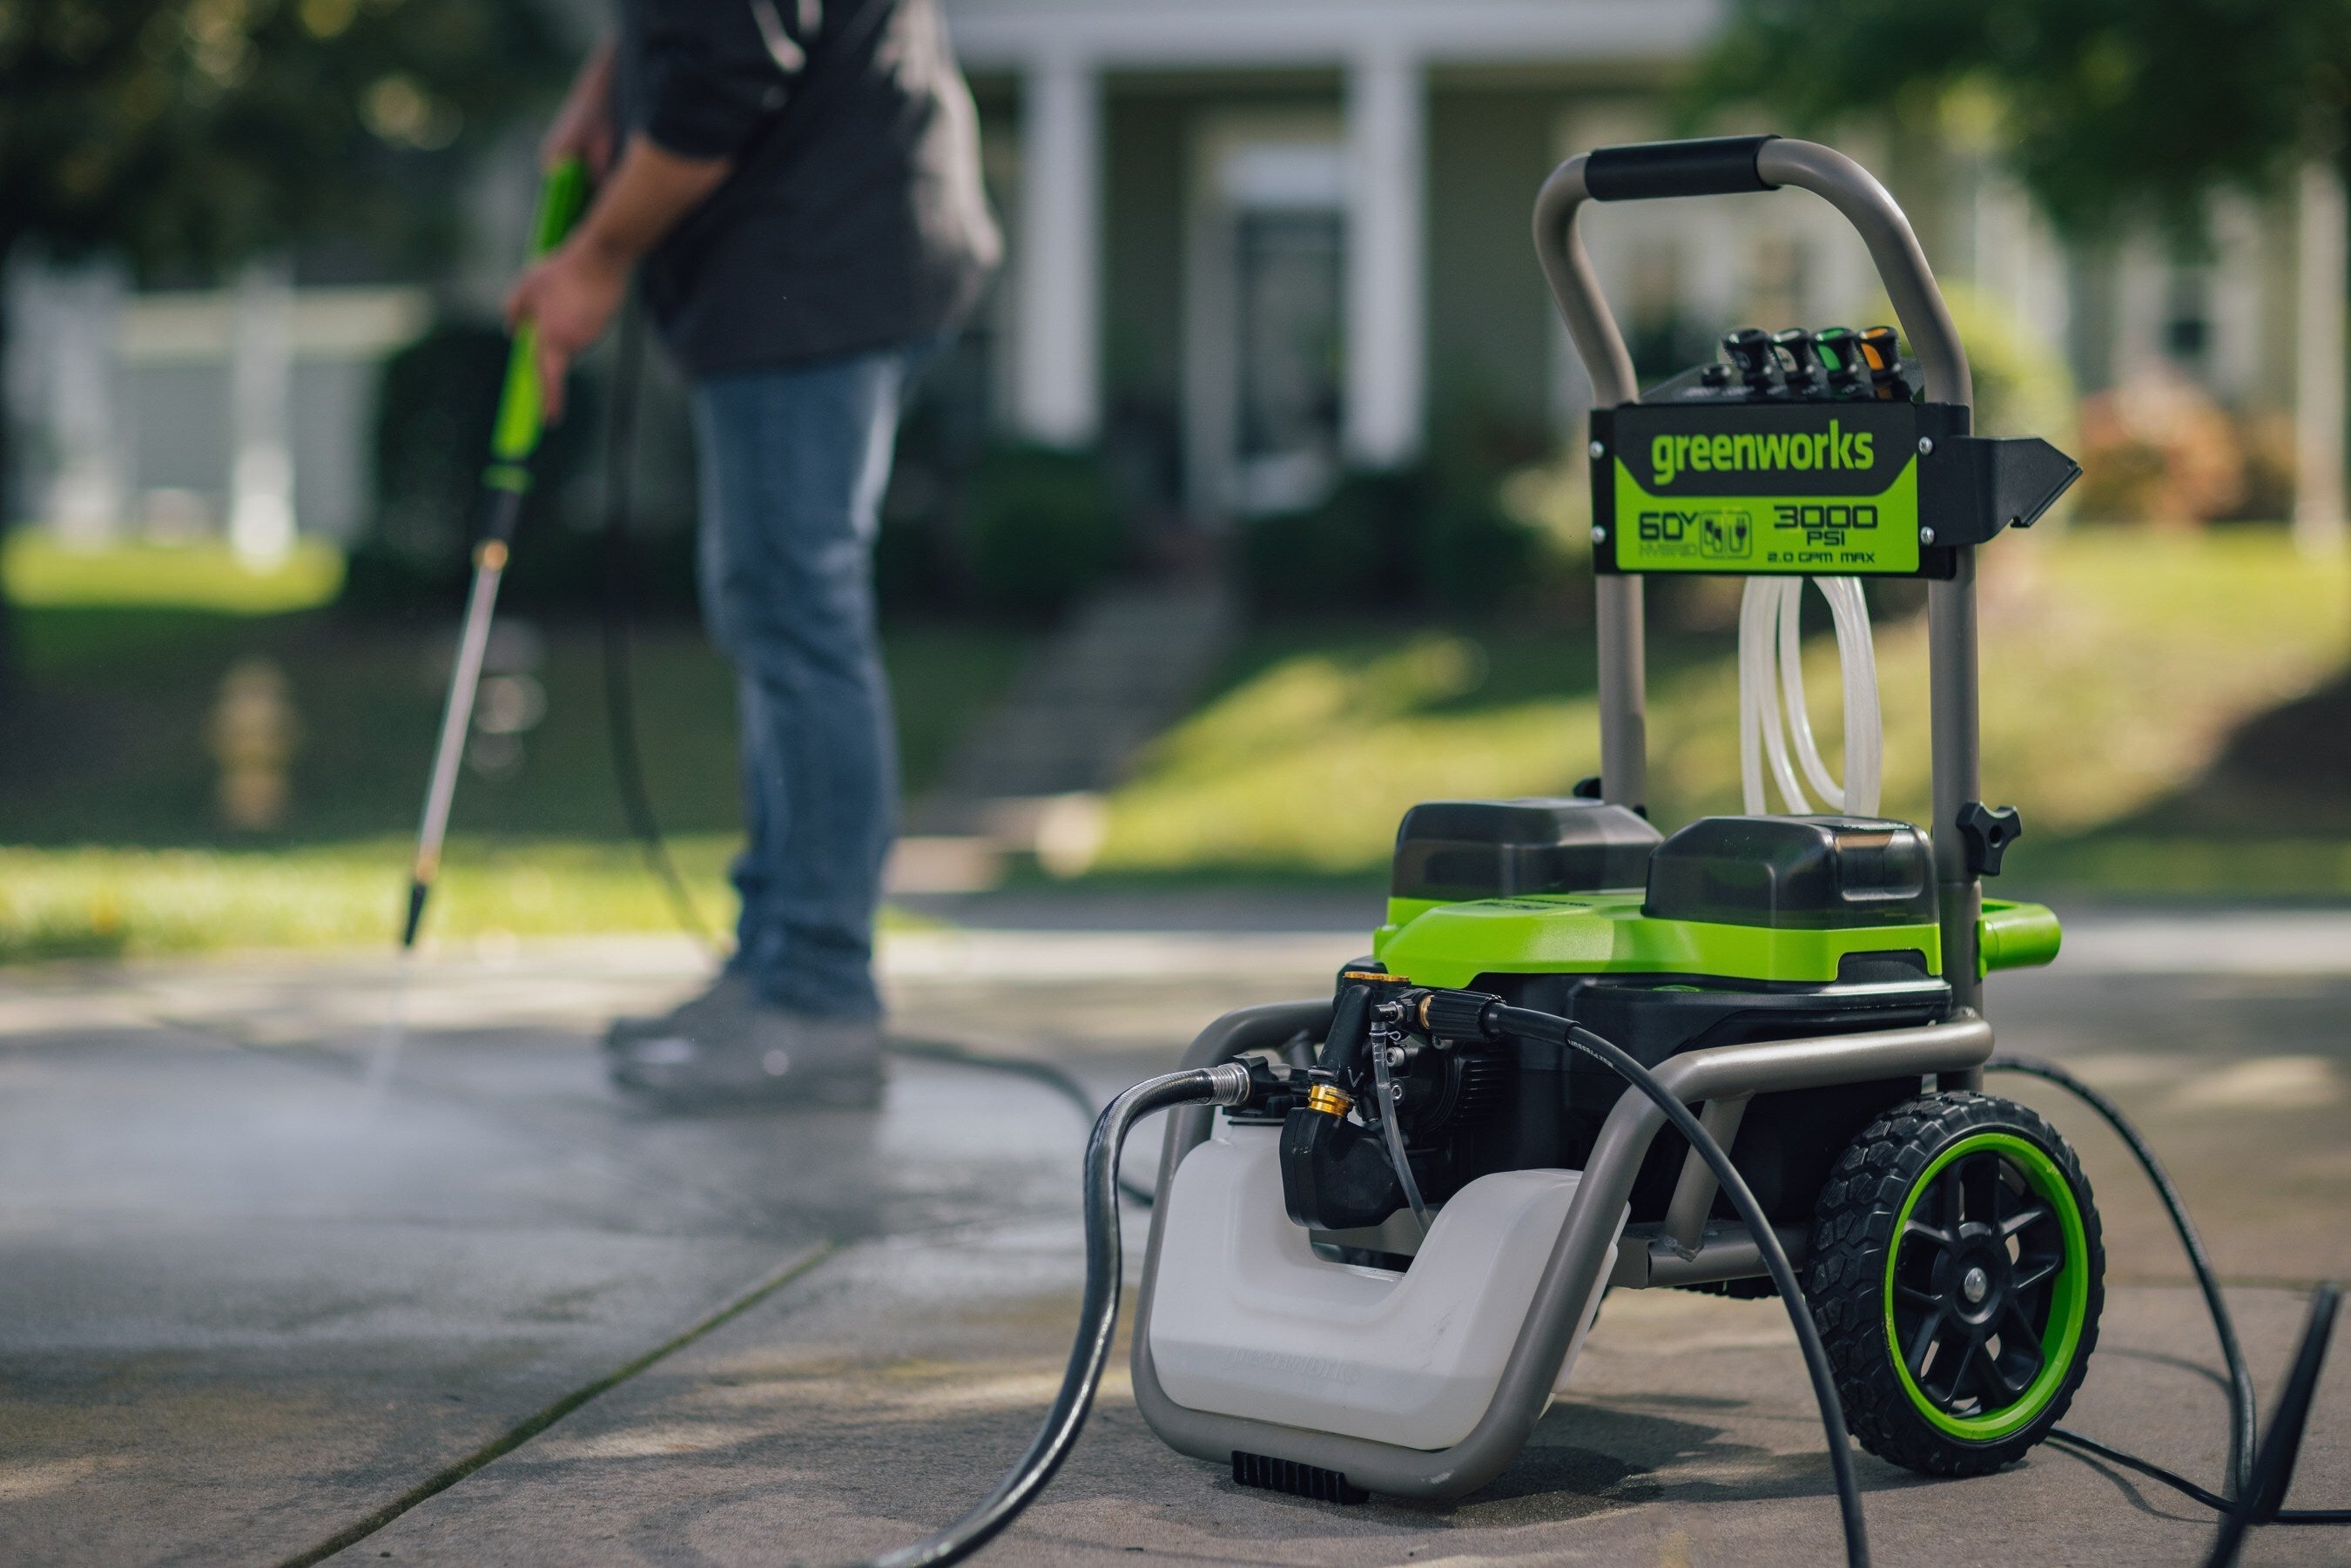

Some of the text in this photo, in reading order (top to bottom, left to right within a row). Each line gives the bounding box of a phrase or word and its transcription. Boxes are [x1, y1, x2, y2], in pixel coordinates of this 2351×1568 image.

[1652, 420, 1874, 485] greenworks
[1774, 505, 1878, 528] 3000
[1807, 530, 1845, 546] PSI
